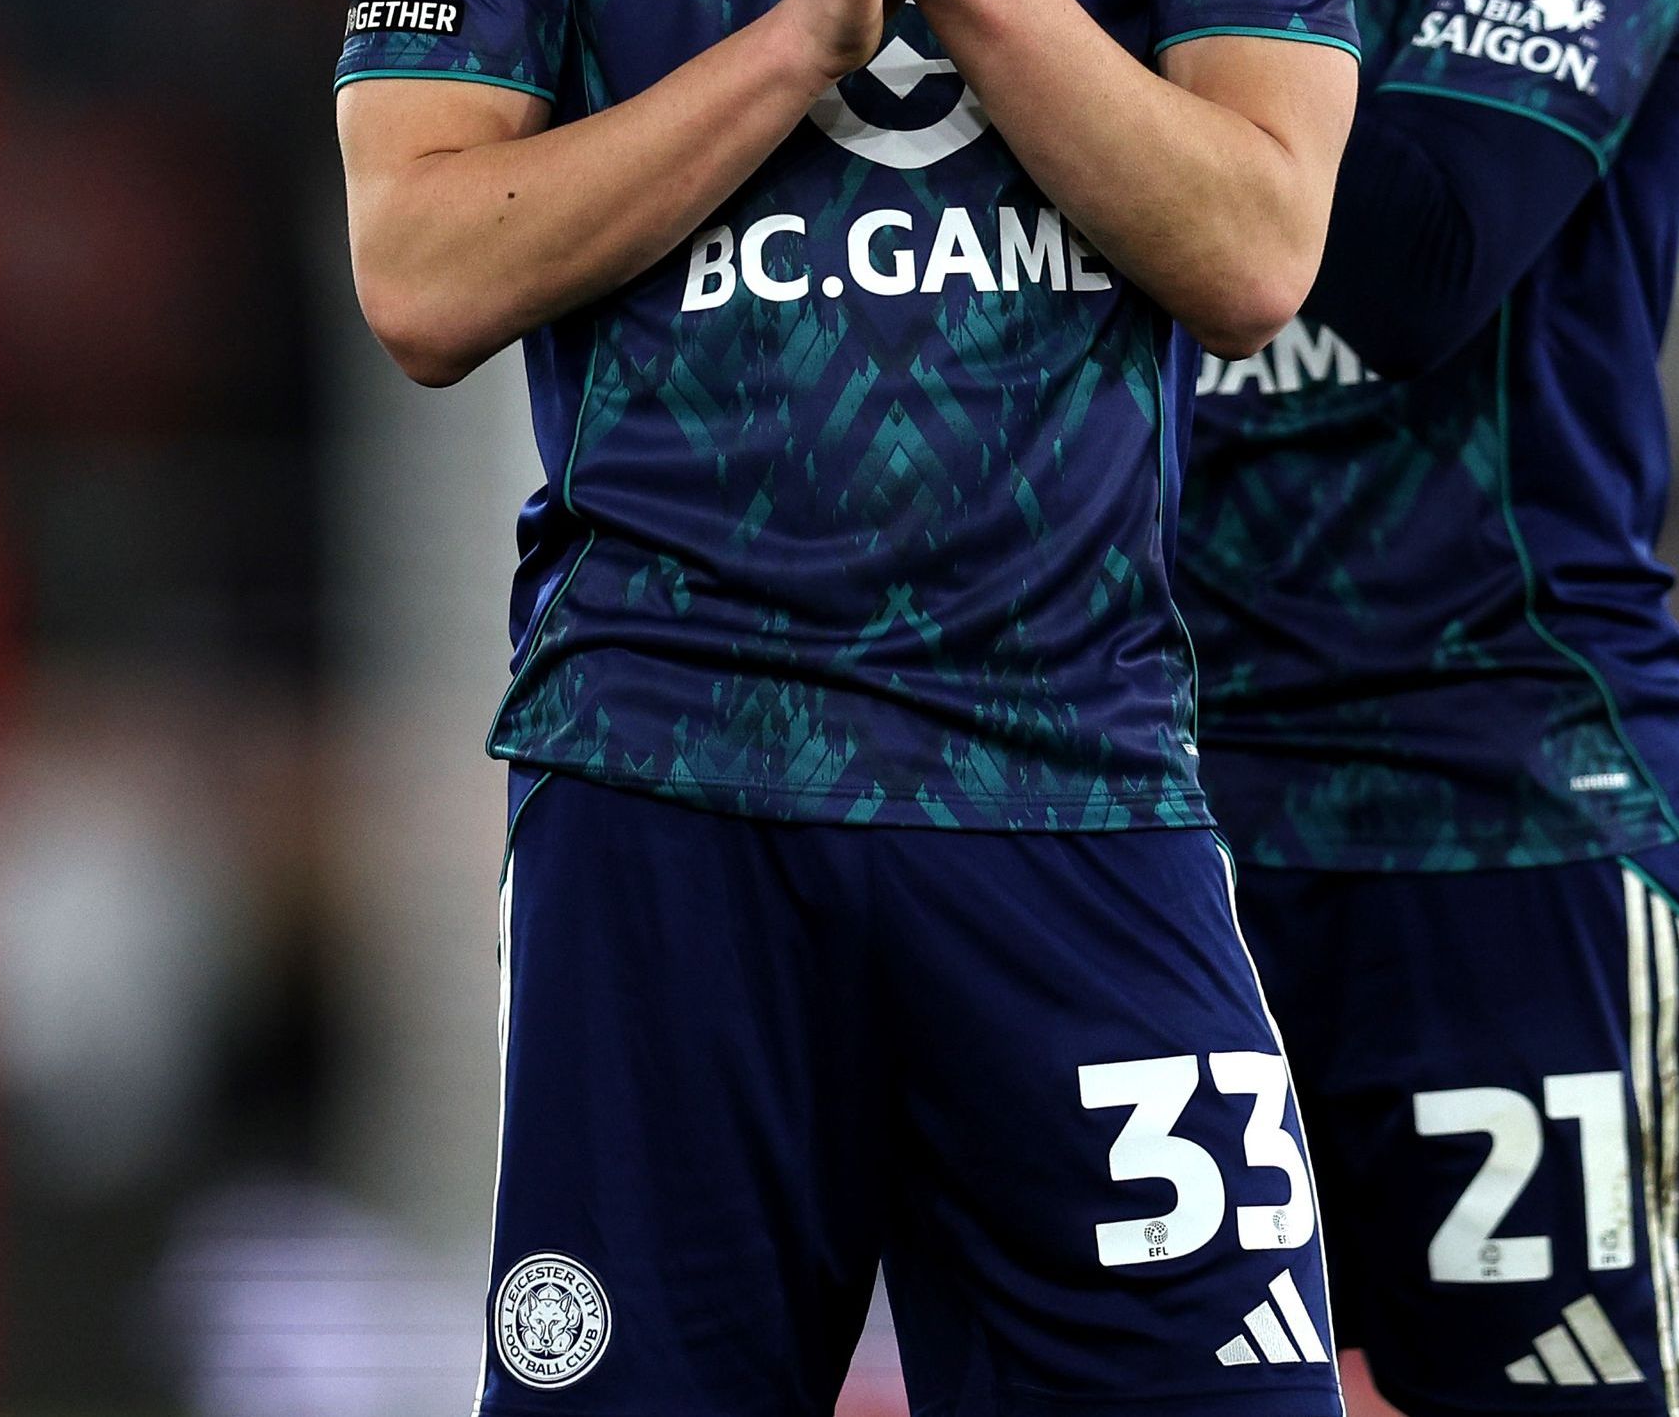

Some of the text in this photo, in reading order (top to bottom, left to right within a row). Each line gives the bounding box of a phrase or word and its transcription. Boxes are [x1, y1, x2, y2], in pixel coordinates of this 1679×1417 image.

[1411, 10, 1599, 92] SAIGON
[680, 206, 1112, 312] BC.GAME
[1077, 1050, 1315, 1267] 33
[1412, 1070, 1636, 1284] 21
[505, 1266, 600, 1320] LEICESTER CITY
[1148, 1246, 1169, 1258] EFL
[505, 1324, 598, 1375] FOOTBALL CLUB
